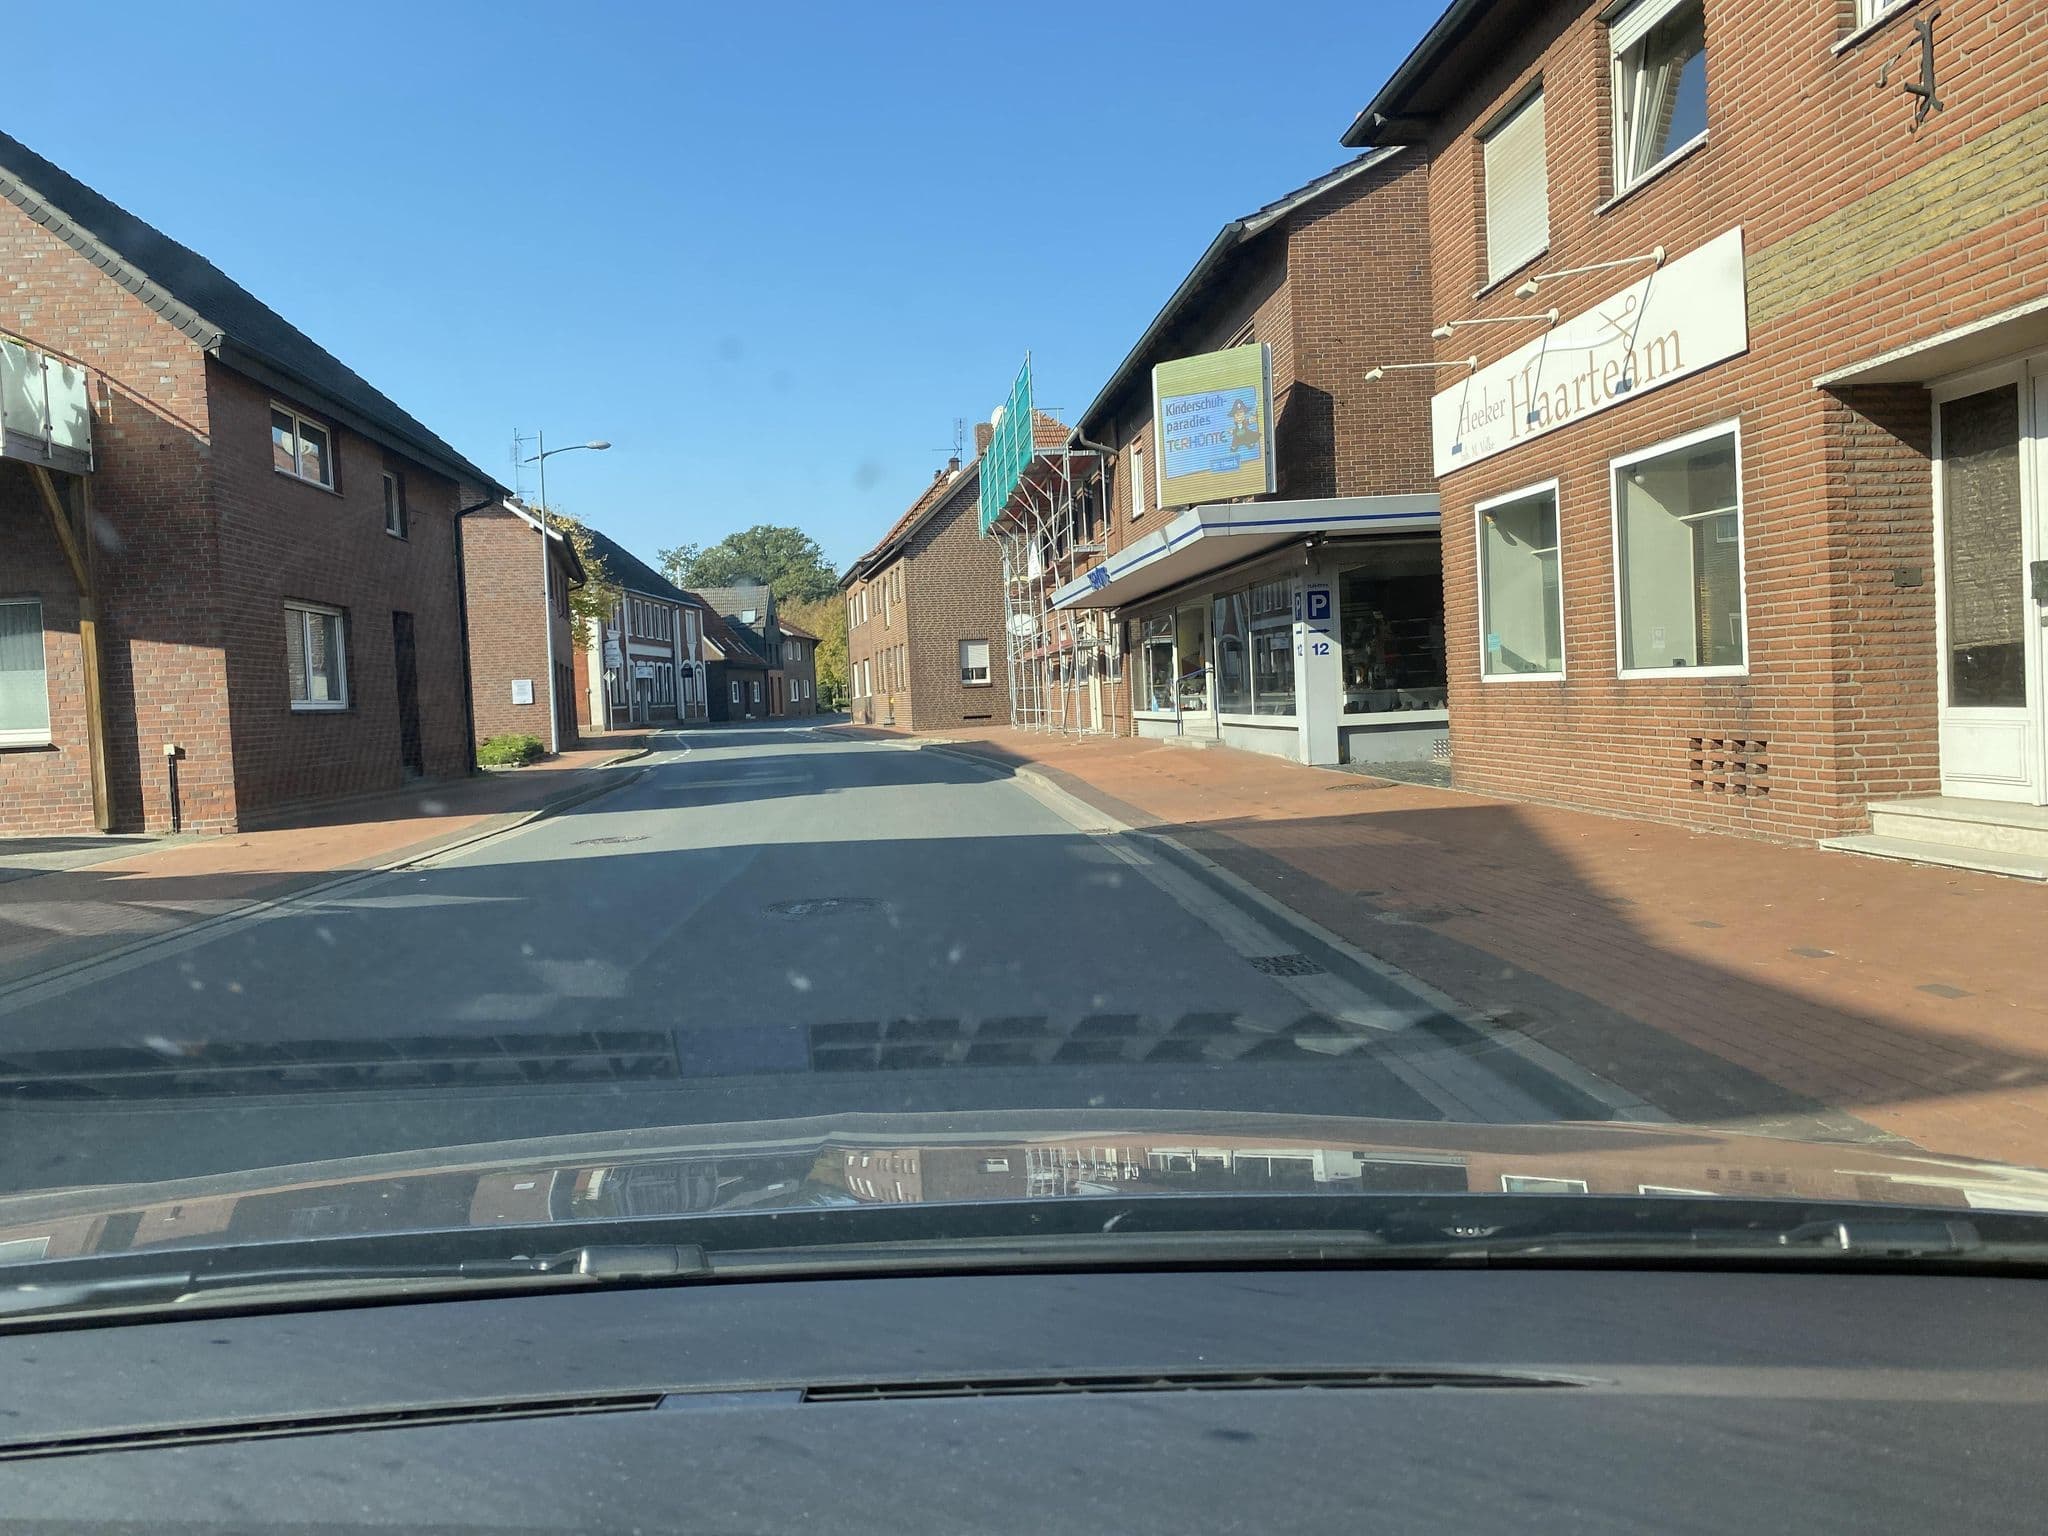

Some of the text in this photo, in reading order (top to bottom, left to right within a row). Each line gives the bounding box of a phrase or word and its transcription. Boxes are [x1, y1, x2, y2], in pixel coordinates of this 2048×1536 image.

[1459, 328, 1686, 441] Heeker Haarteam
[1165, 395, 1227, 416] Kinderschuh-
[1166, 414, 1212, 435] paradies
[1311, 594, 1328, 617] P
[1311, 642, 1330, 656] 12
